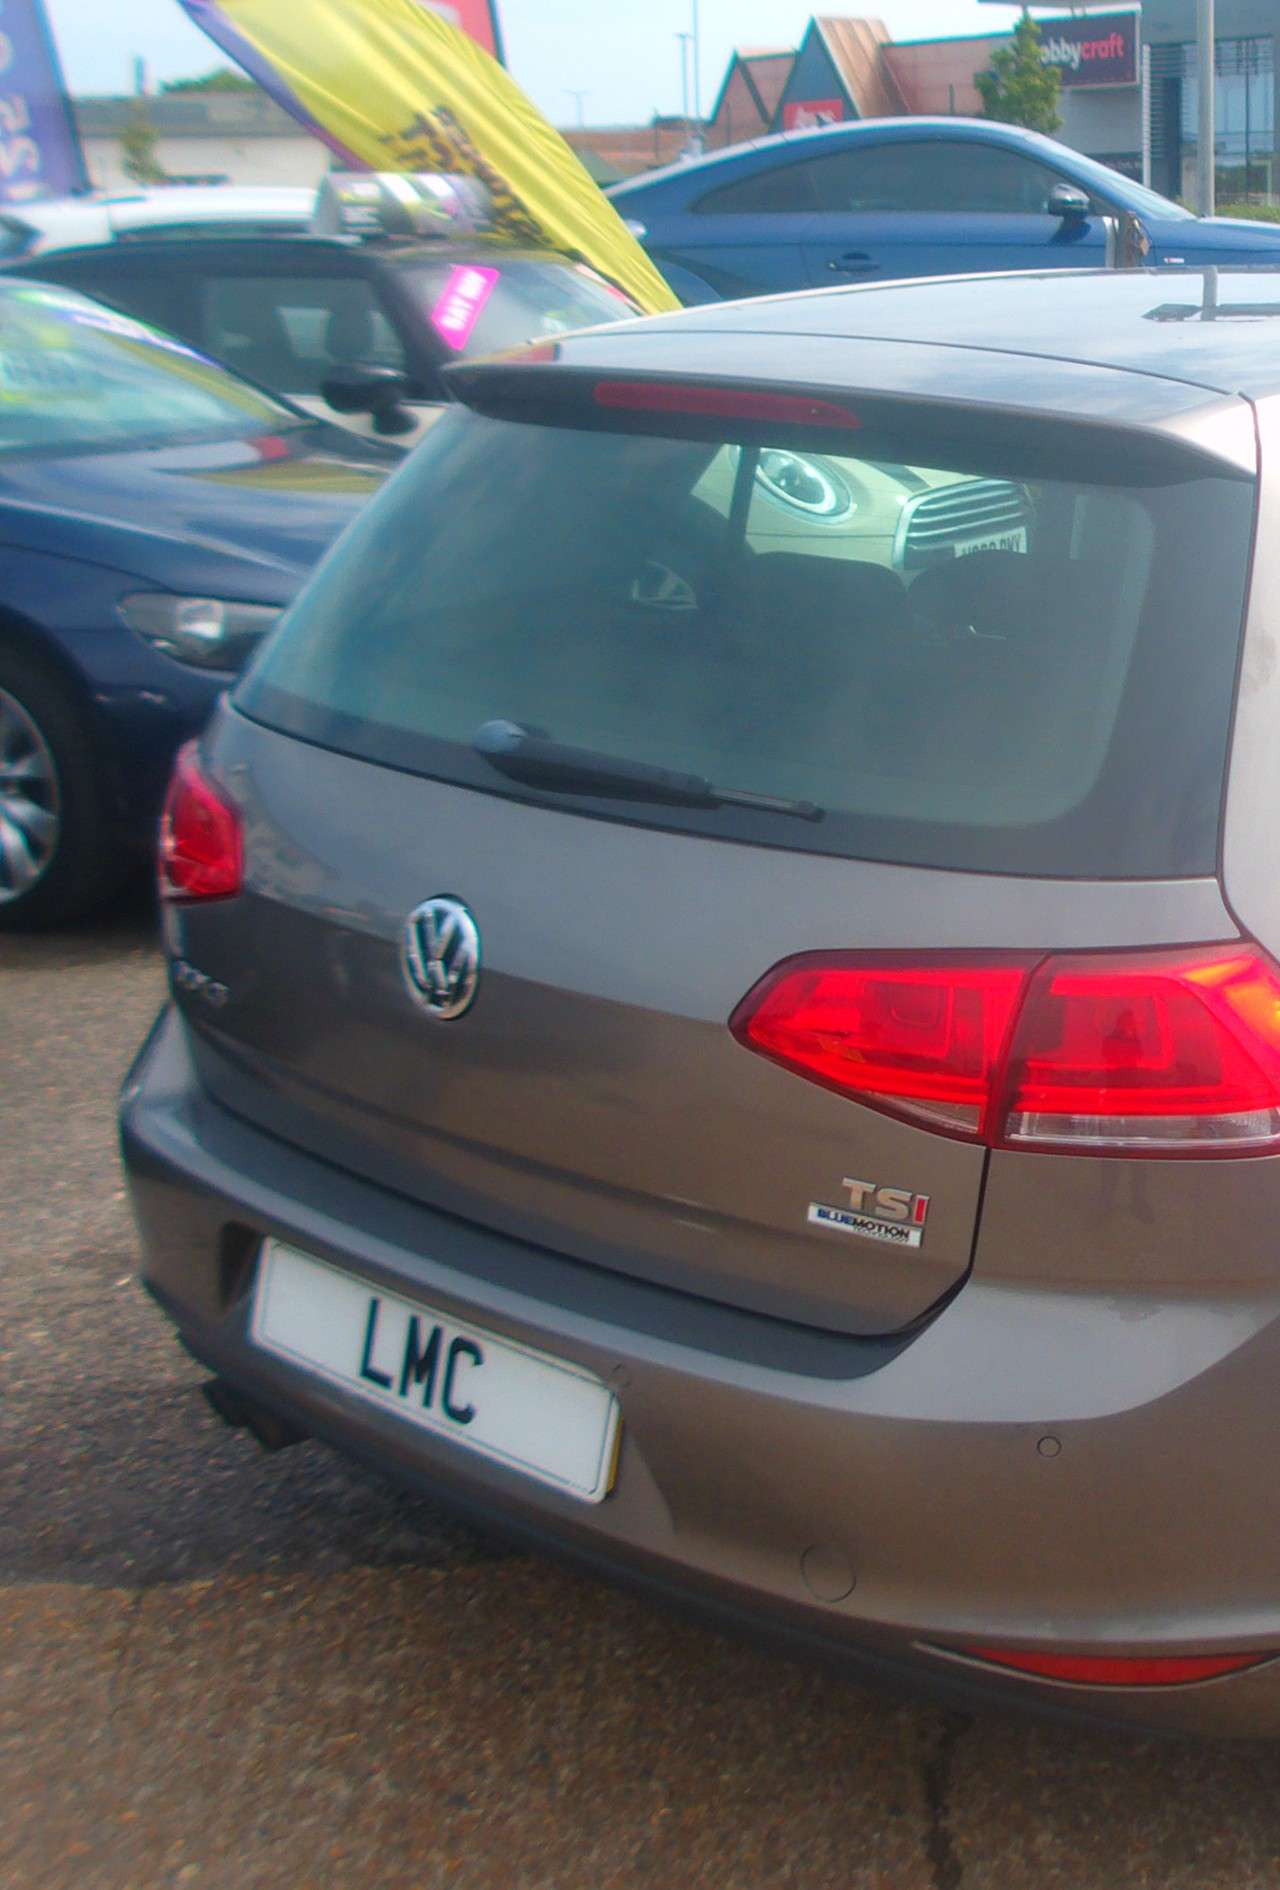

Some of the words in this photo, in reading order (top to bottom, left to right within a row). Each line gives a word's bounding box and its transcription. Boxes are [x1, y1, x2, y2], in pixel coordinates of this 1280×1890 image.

[817, 1207, 911, 1240] BLUEMOTION
[842, 1176, 930, 1225] TSI
[360, 1296, 487, 1426] LMC
